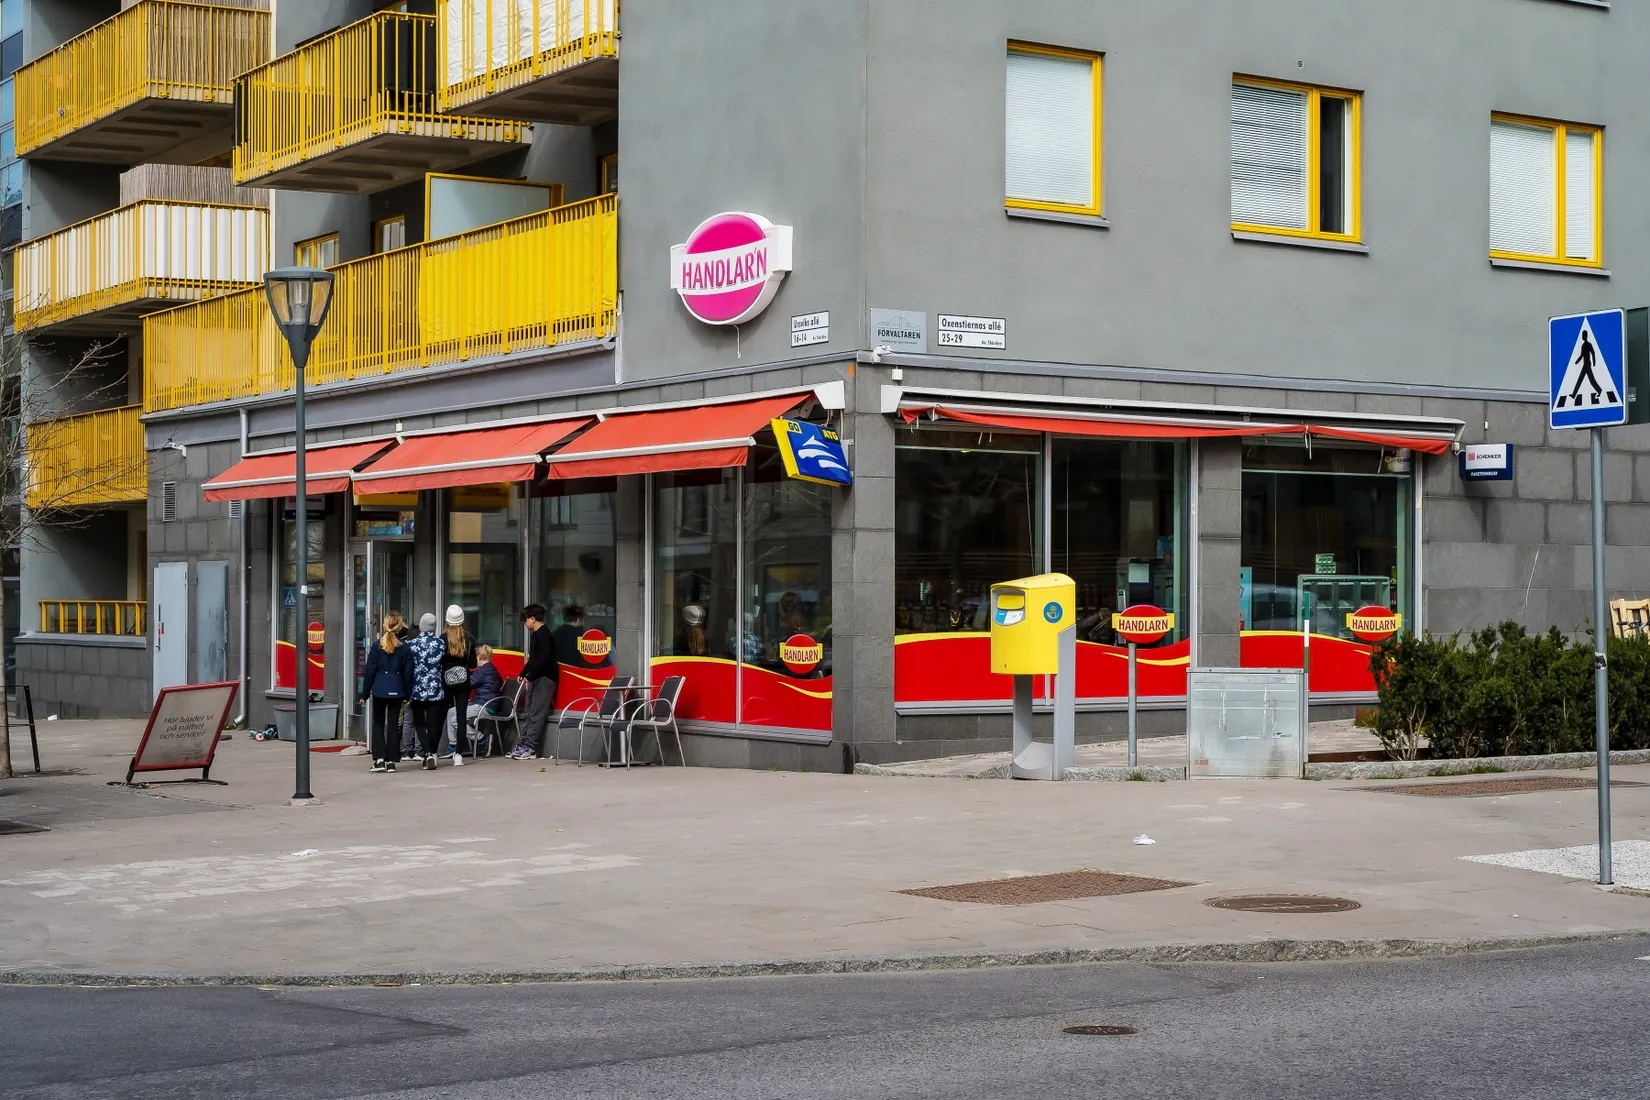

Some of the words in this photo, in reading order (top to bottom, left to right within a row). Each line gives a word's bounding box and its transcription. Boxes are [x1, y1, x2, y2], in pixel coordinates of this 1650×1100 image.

[682, 246, 767, 289] HANDLAR'N
[941, 318, 986, 330] Oxenstiernas
[988, 320, 1002, 331] allé
[941, 334, 963, 344] 25-29
[822, 430, 839, 440] ATG
[1118, 618, 1169, 632] HANDLARN
[1352, 618, 1396, 631] HANDLARN
[580, 641, 608, 654] HANDLARN
[784, 648, 819, 662] HANDLARN
[179, 715, 205, 724] bjuder
[166, 724, 177, 732] på
